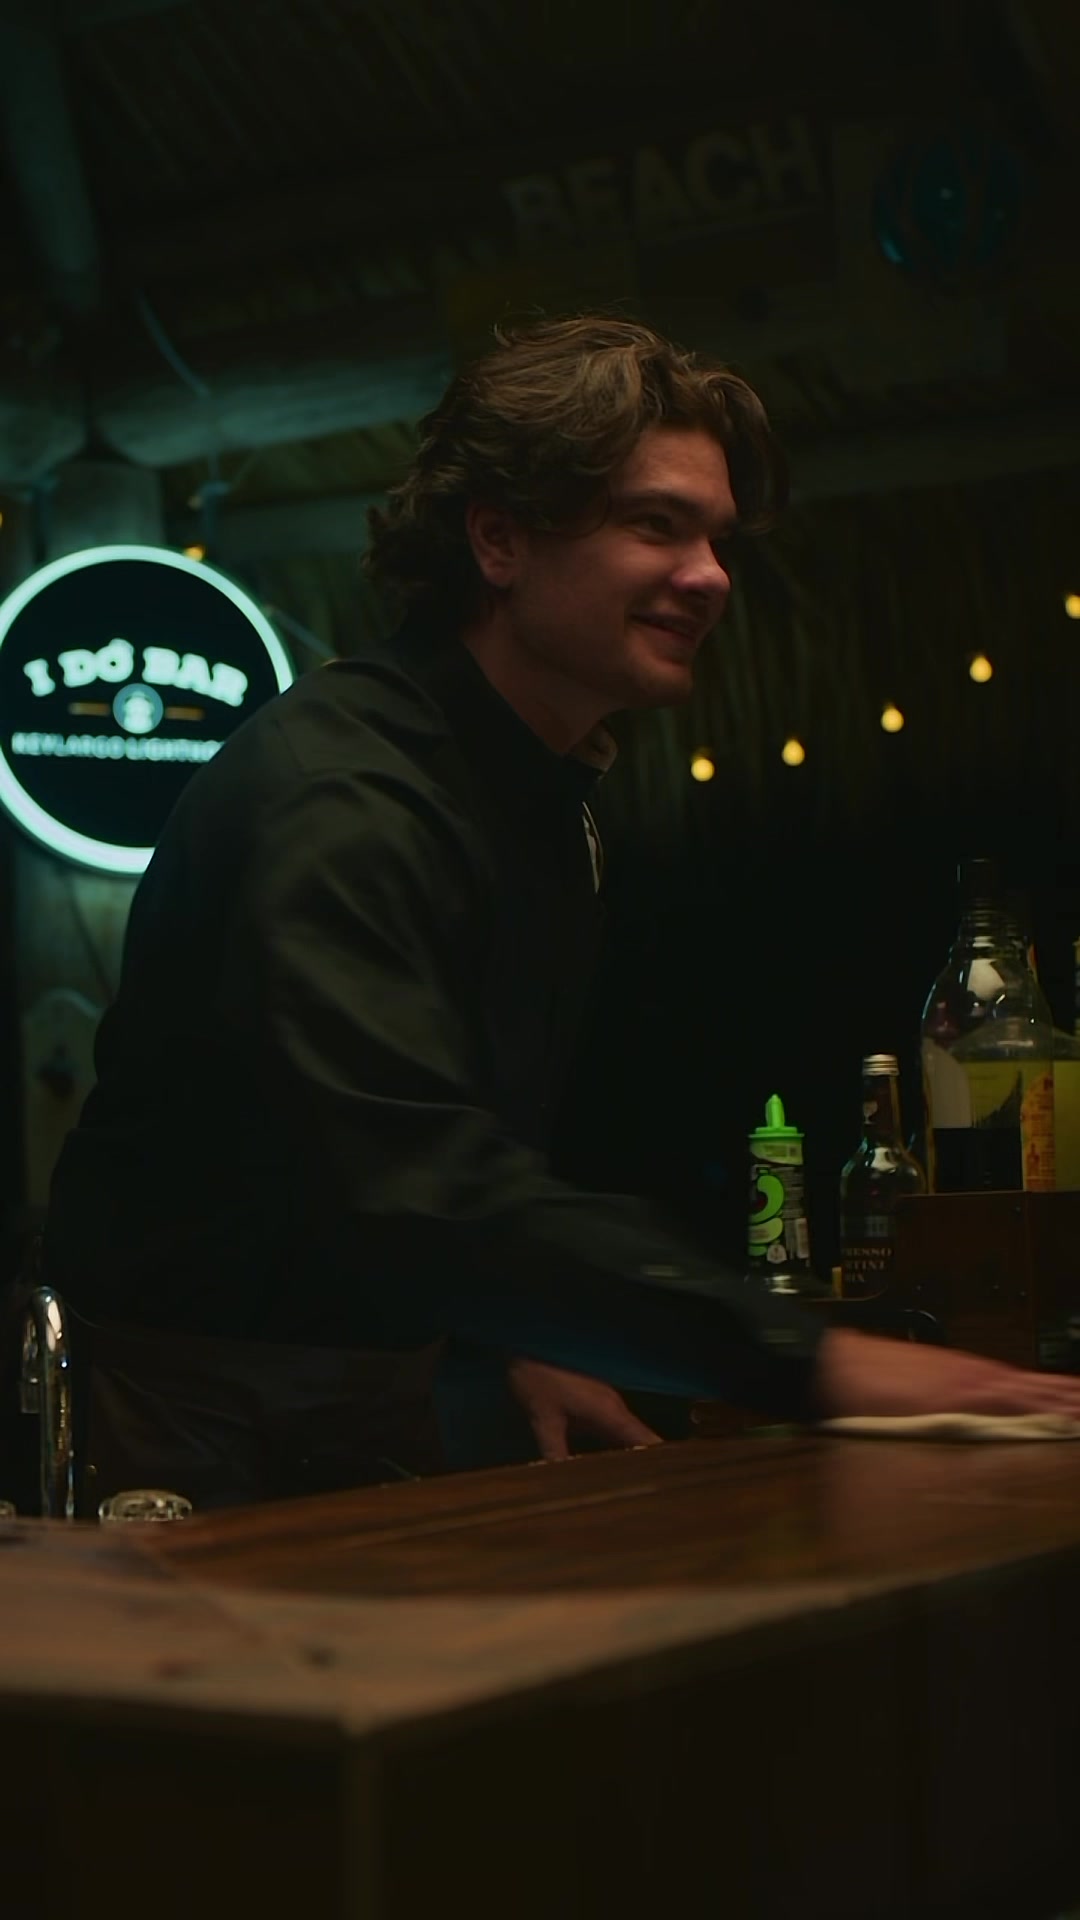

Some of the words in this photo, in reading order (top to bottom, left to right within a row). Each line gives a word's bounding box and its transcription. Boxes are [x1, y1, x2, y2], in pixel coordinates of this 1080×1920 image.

[502, 114, 820, 249] BEACH
[23, 658, 55, 696] I
[142, 646, 248, 707] BAR
